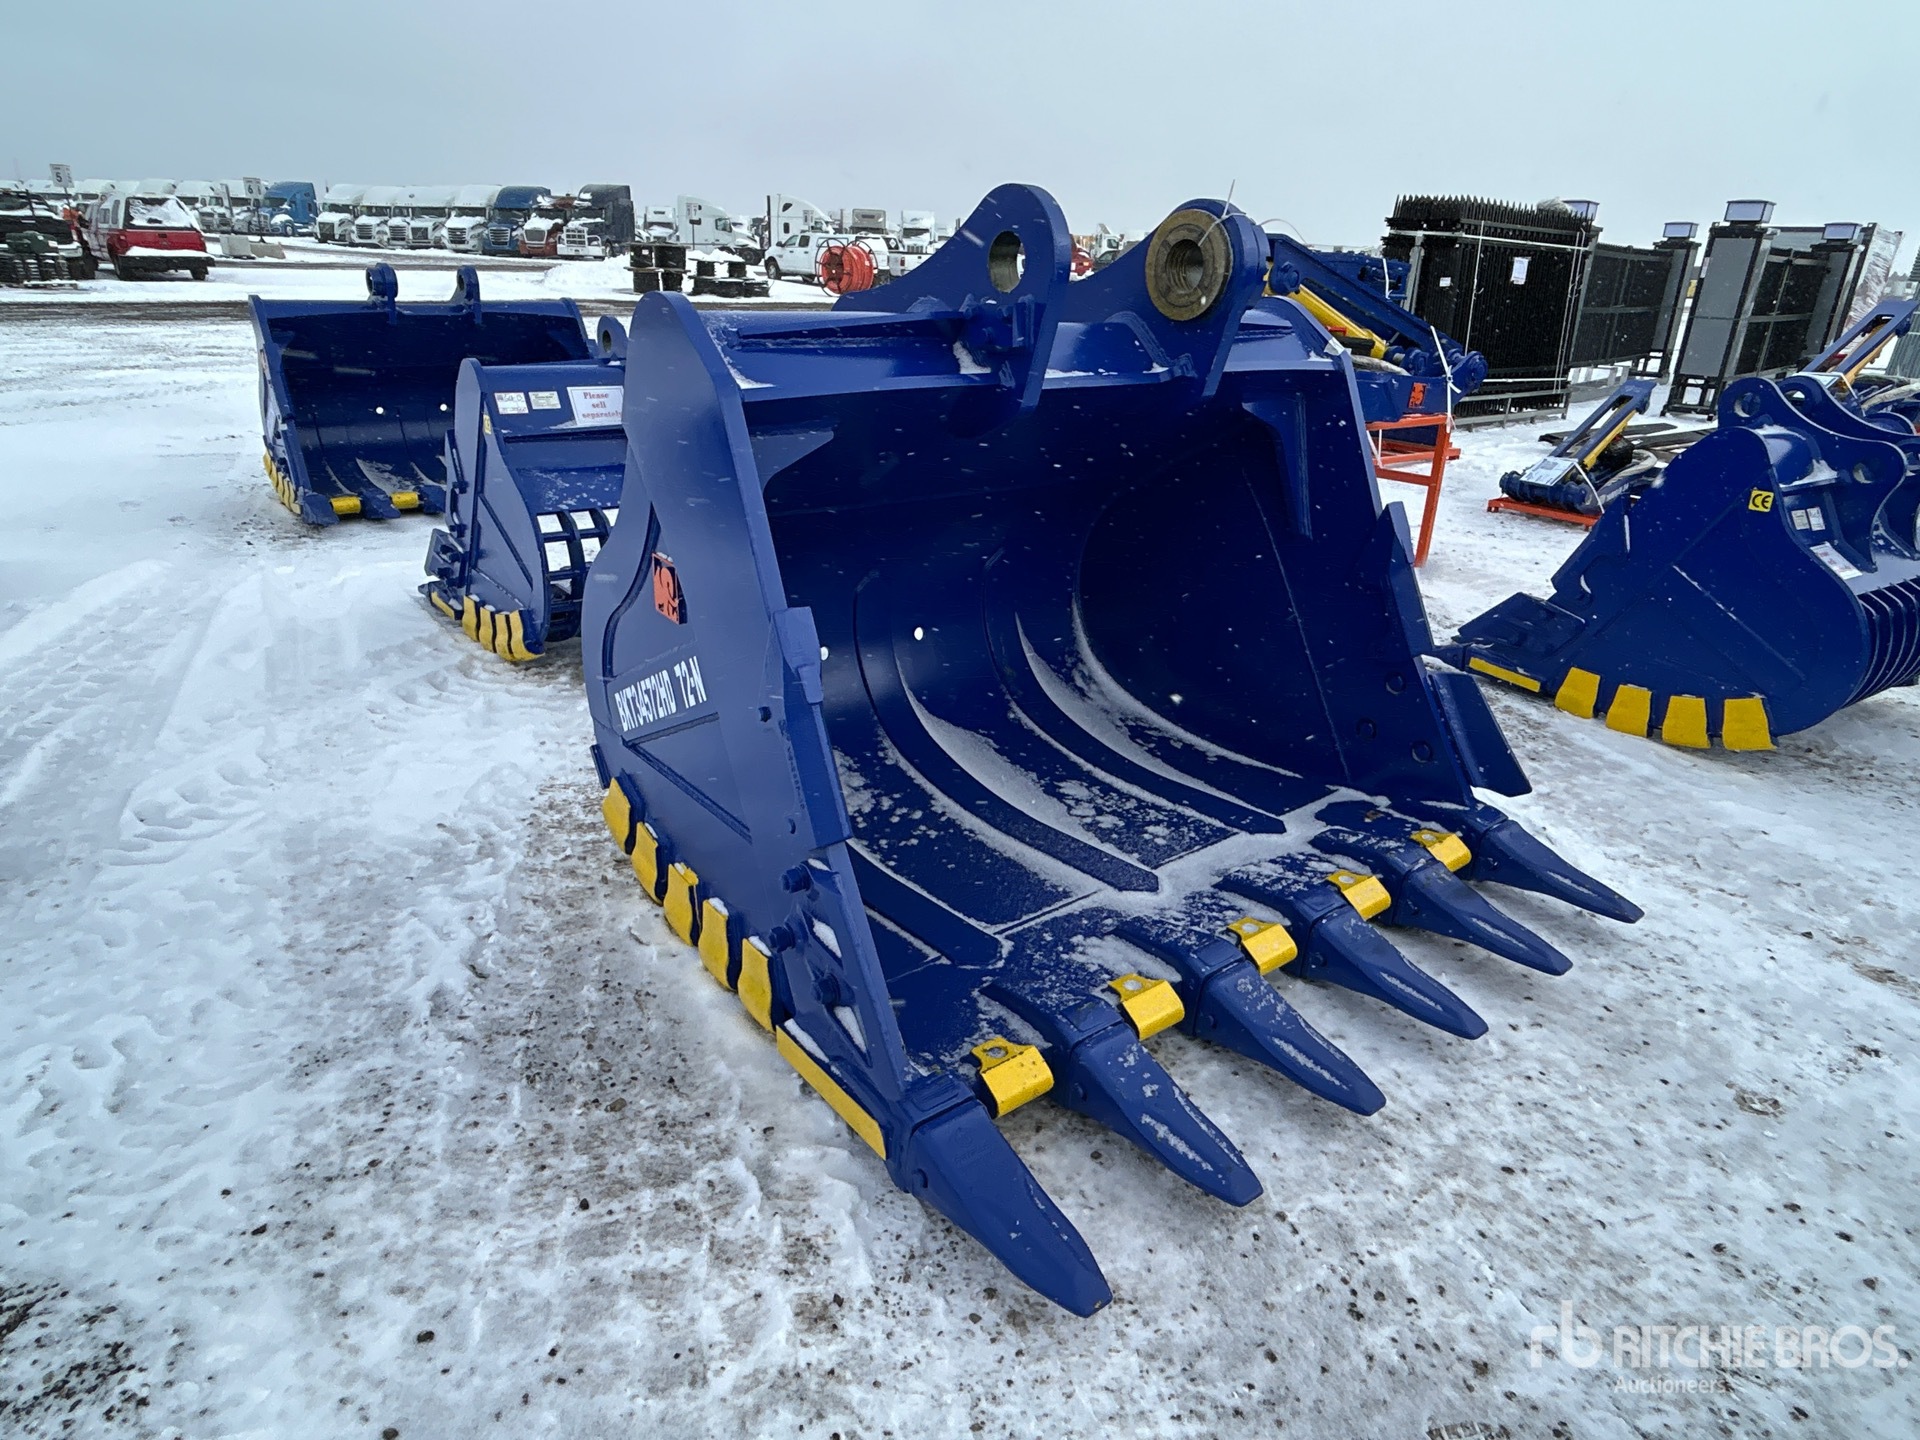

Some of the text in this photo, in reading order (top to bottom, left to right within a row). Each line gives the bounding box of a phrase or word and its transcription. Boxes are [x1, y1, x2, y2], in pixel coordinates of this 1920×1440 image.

[55, 171, 63, 183] 5
[247, 184, 254, 195] 6
[583, 392, 609, 400] Please
[591, 401, 607, 409] sell
[1751, 493, 1772, 510] CE
[614, 669, 677, 732] BKT34572HD
